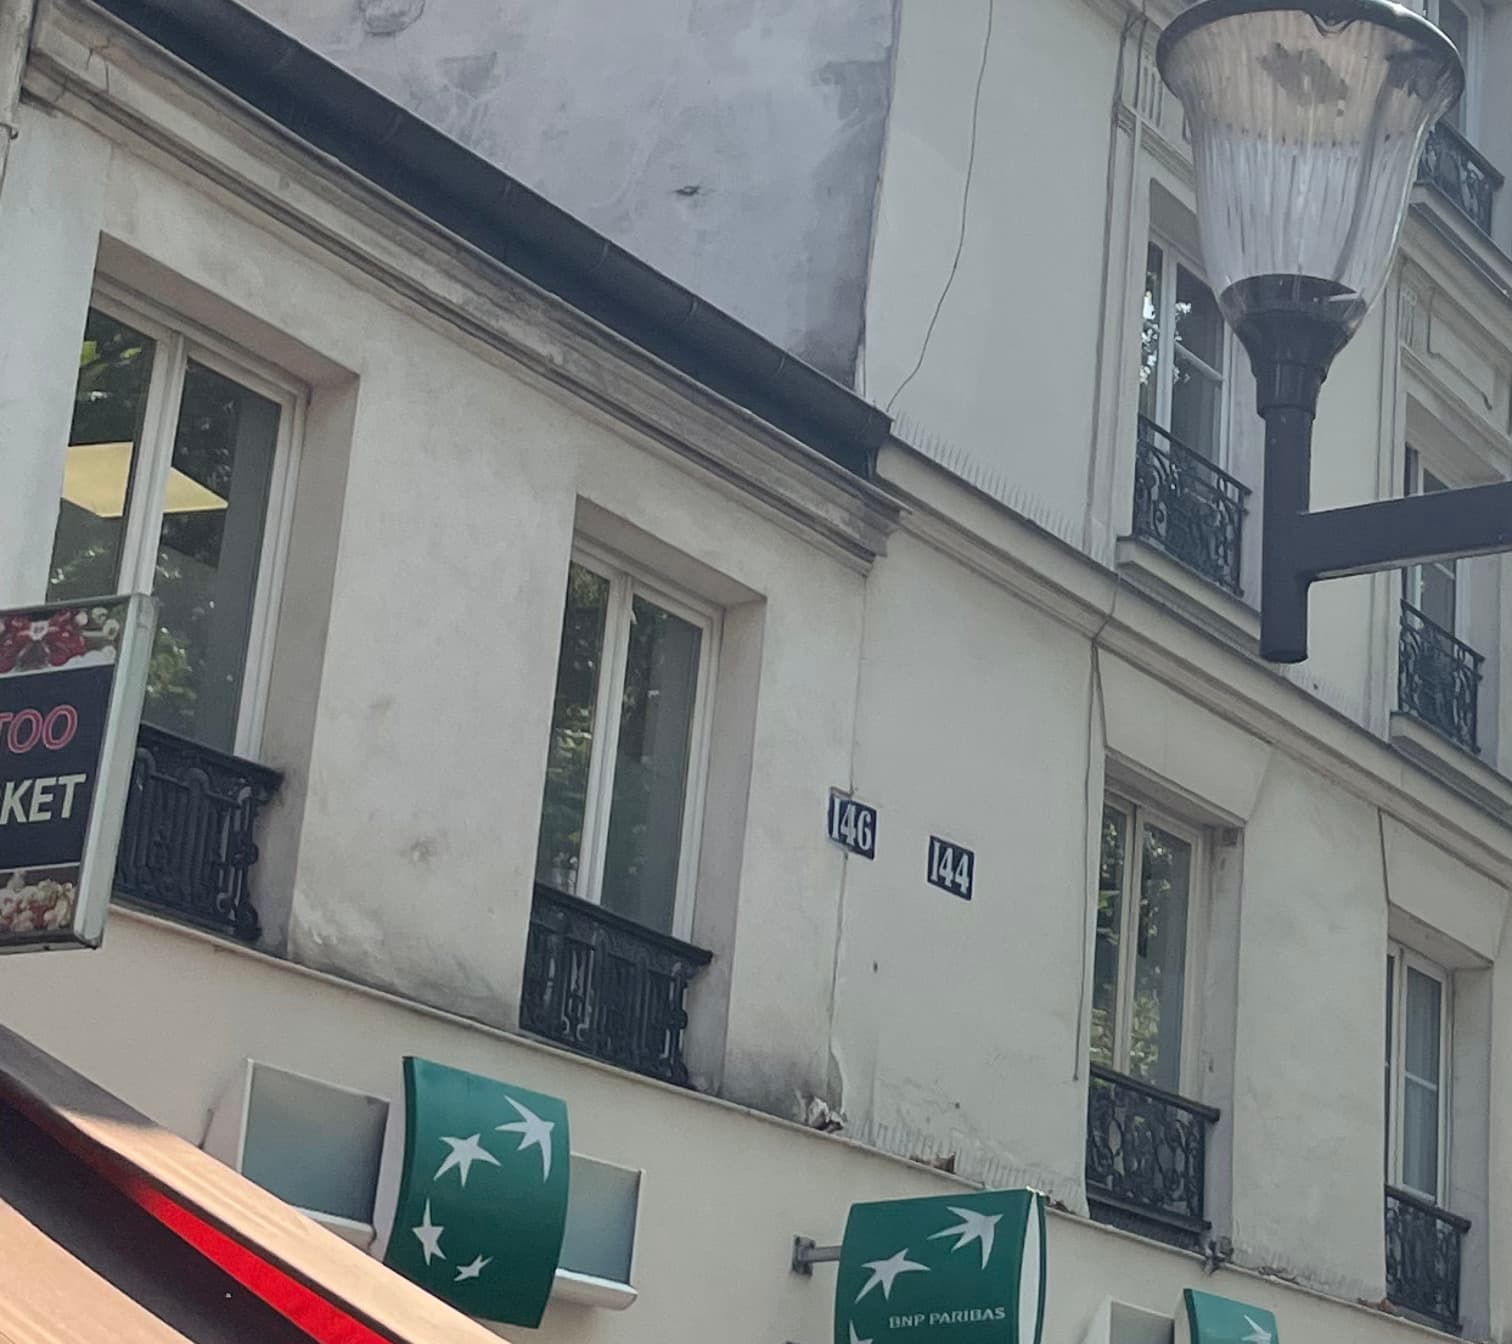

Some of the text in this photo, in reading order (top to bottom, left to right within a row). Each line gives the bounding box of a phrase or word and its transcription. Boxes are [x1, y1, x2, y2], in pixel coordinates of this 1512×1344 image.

[832, 796, 872, 850] 146
[930, 841, 970, 894] 144
[889, 1307, 1005, 1328] BNP PARIBAS
